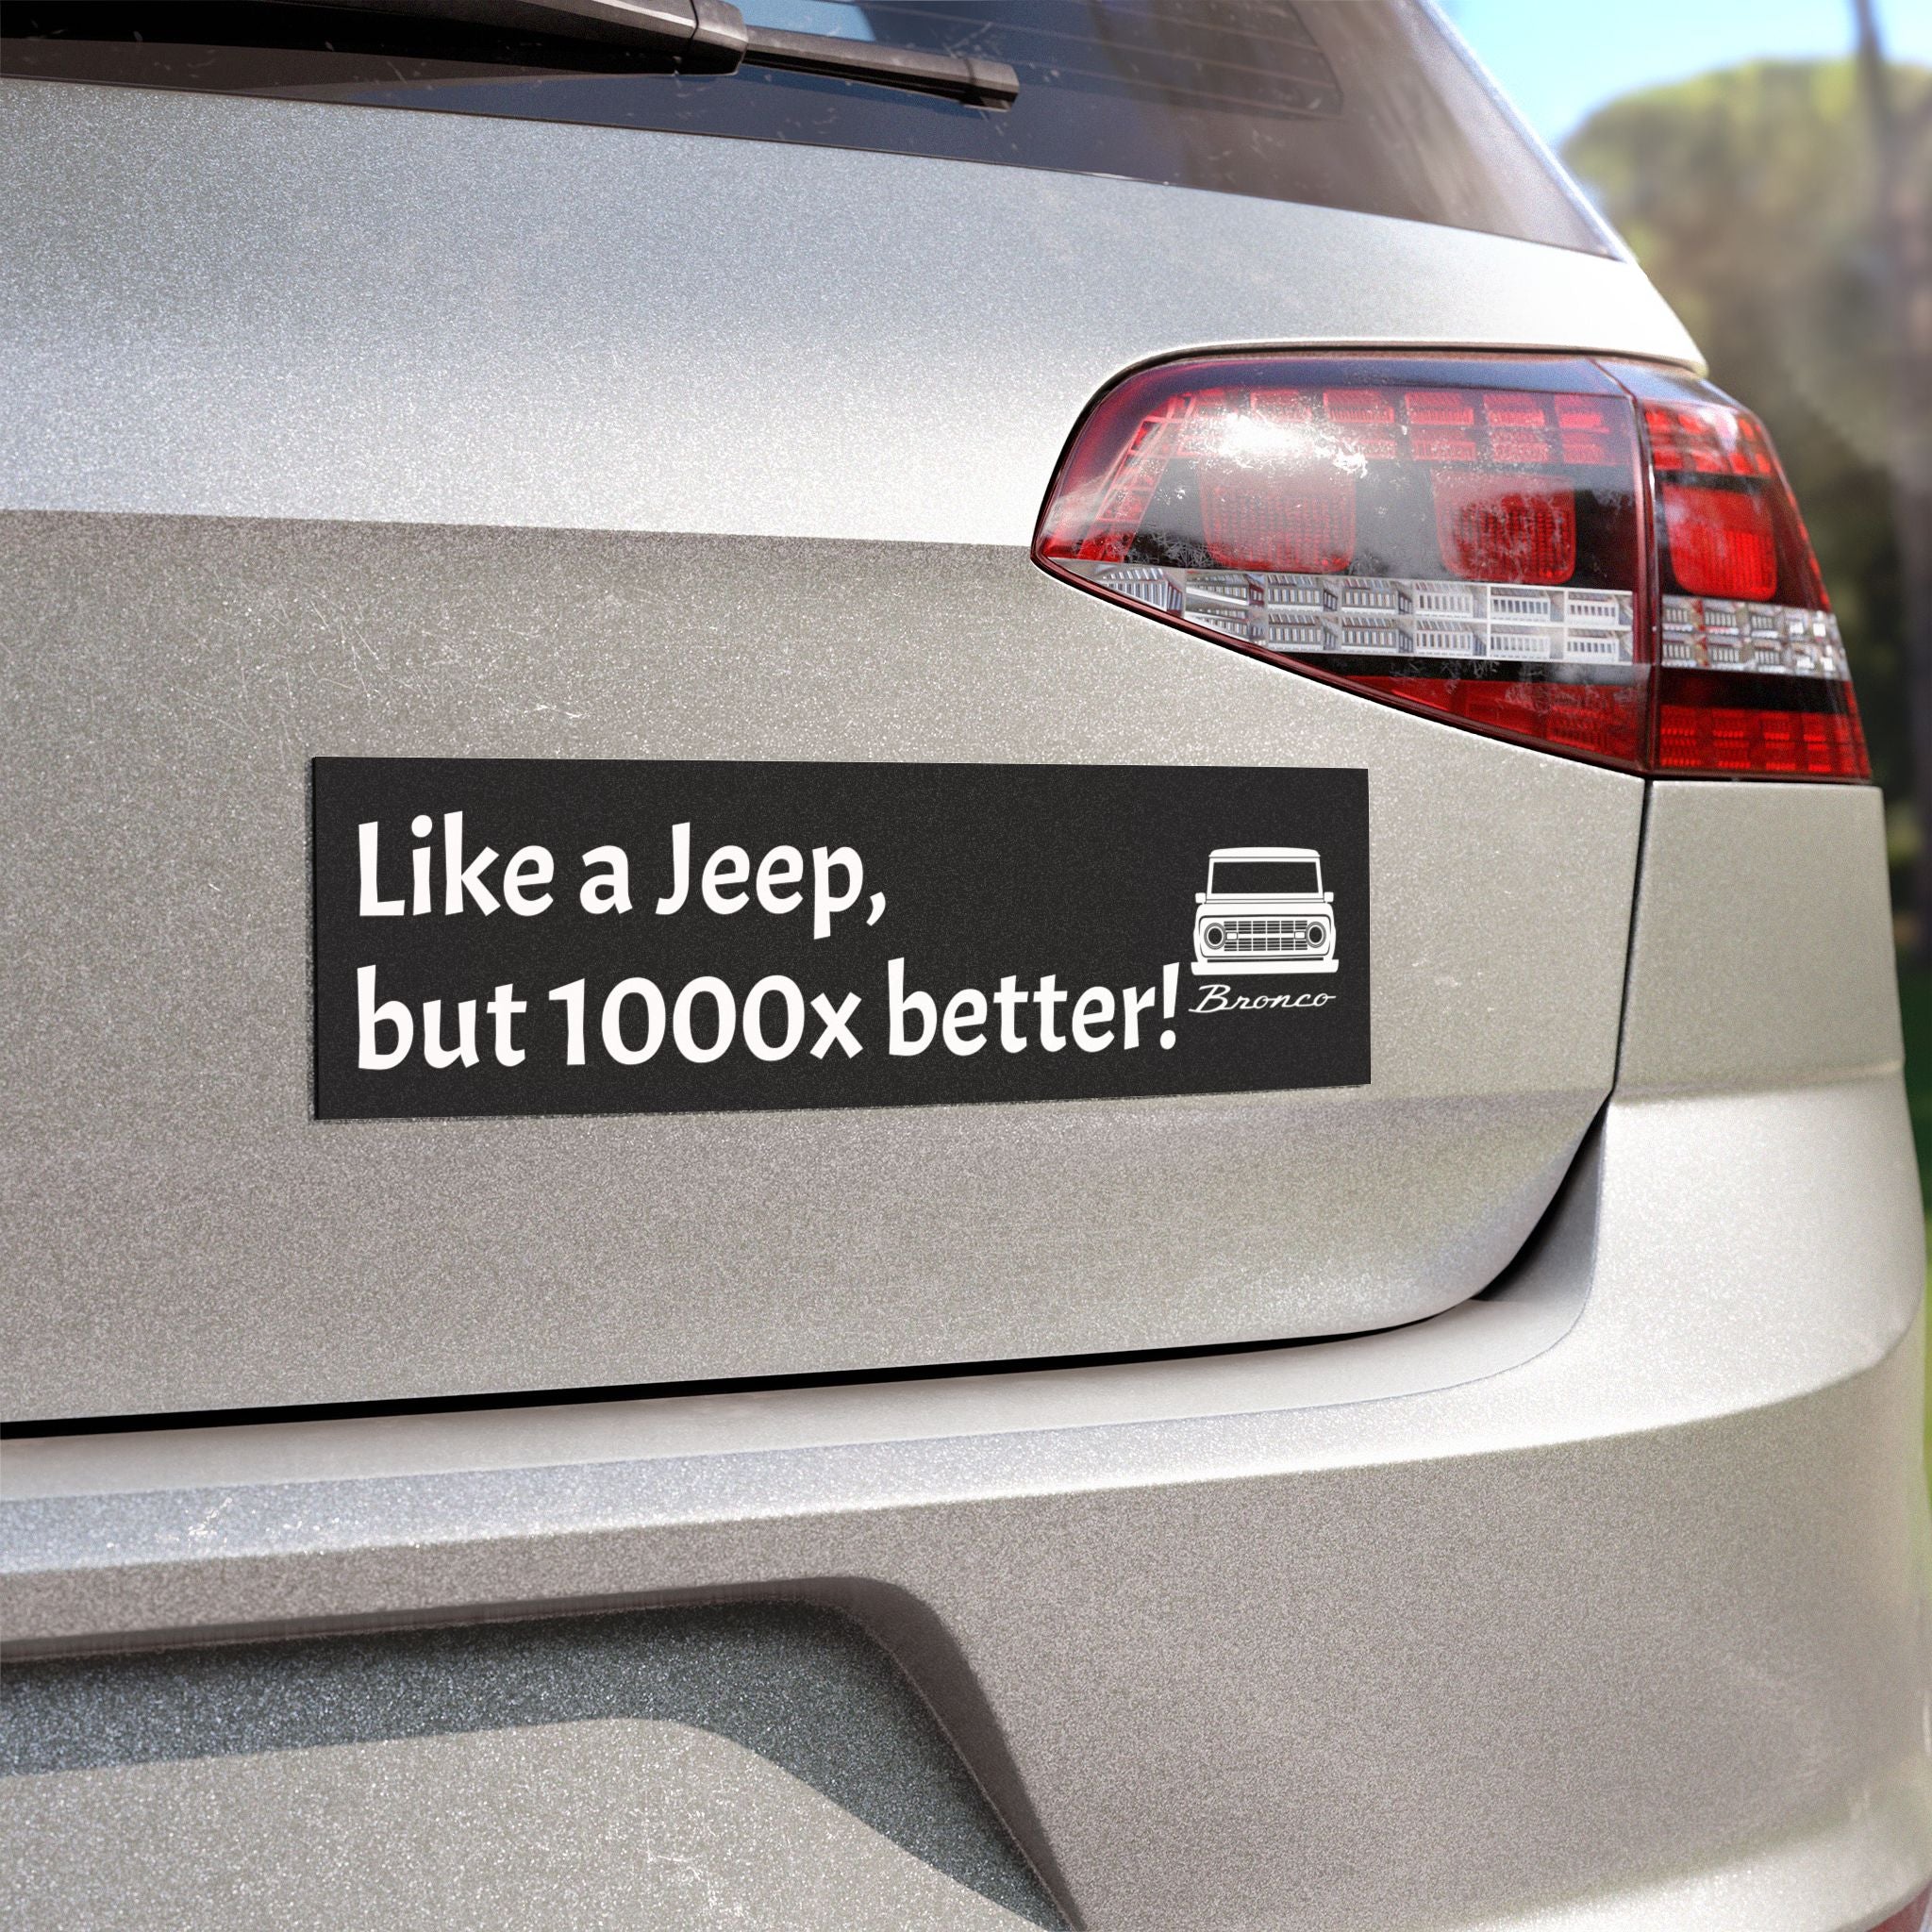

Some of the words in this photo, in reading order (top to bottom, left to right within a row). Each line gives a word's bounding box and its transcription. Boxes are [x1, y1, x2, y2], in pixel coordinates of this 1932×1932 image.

[358, 810, 555, 917] Like
[579, 844, 633, 915] a
[655, 822, 887, 941] Jeep,
[357, 964, 527, 1071] but
[548, 974, 864, 1066] 1000x
[887, 957, 1180, 1057] better!
[1188, 984, 1337, 1014] Bronco
